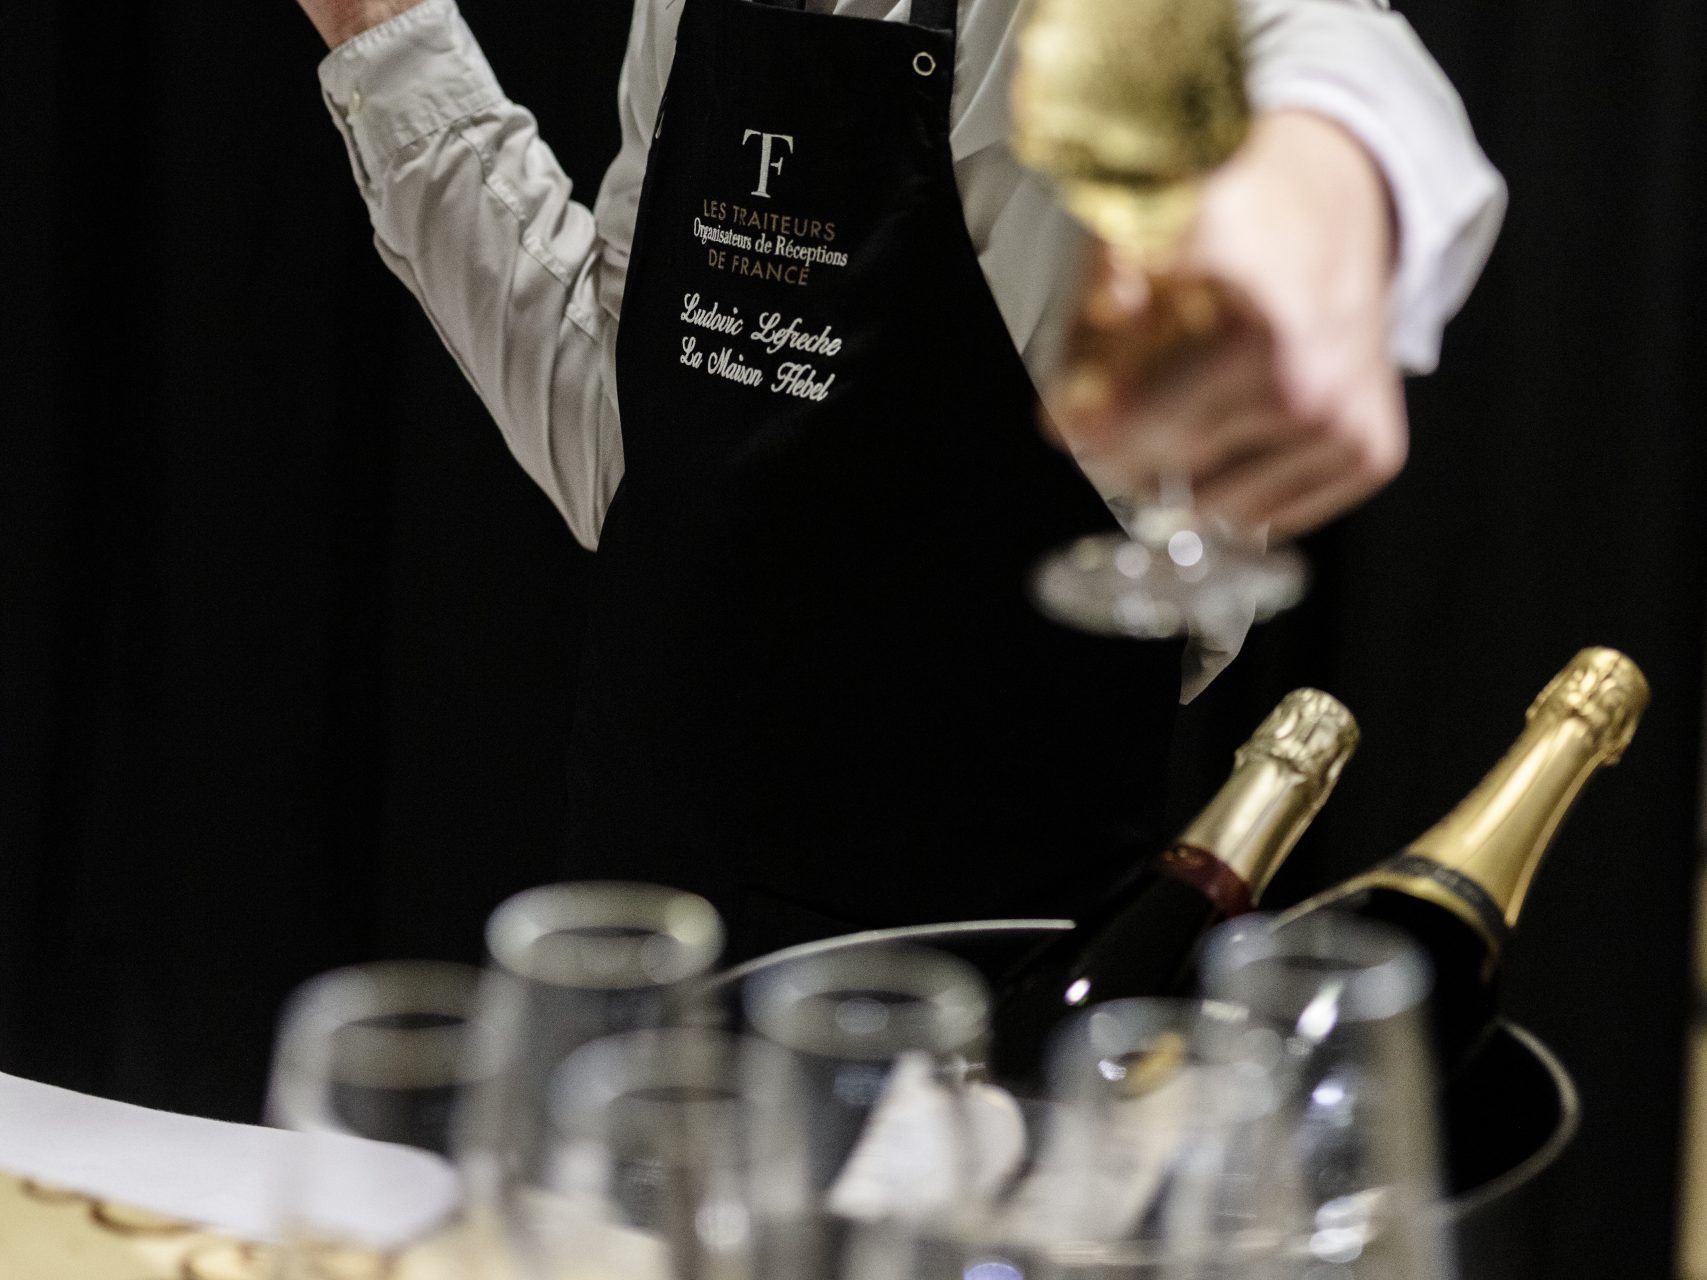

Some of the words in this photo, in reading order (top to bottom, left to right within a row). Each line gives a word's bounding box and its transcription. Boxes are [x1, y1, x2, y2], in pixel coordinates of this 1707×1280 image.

[693, 217, 752, 250] Organisateurs
[755, 233, 772, 254] de
[775, 235, 849, 267] Réceptions
[703, 199, 727, 221] LES
[733, 205, 836, 241] TRAITEURS
[708, 249, 726, 269] DE
[731, 255, 811, 286] FRANCE
[680, 293, 744, 336] Ludovic
[750, 312, 842, 357] Lefreche
[680, 336, 703, 369] La
[707, 347, 763, 387] Maison
